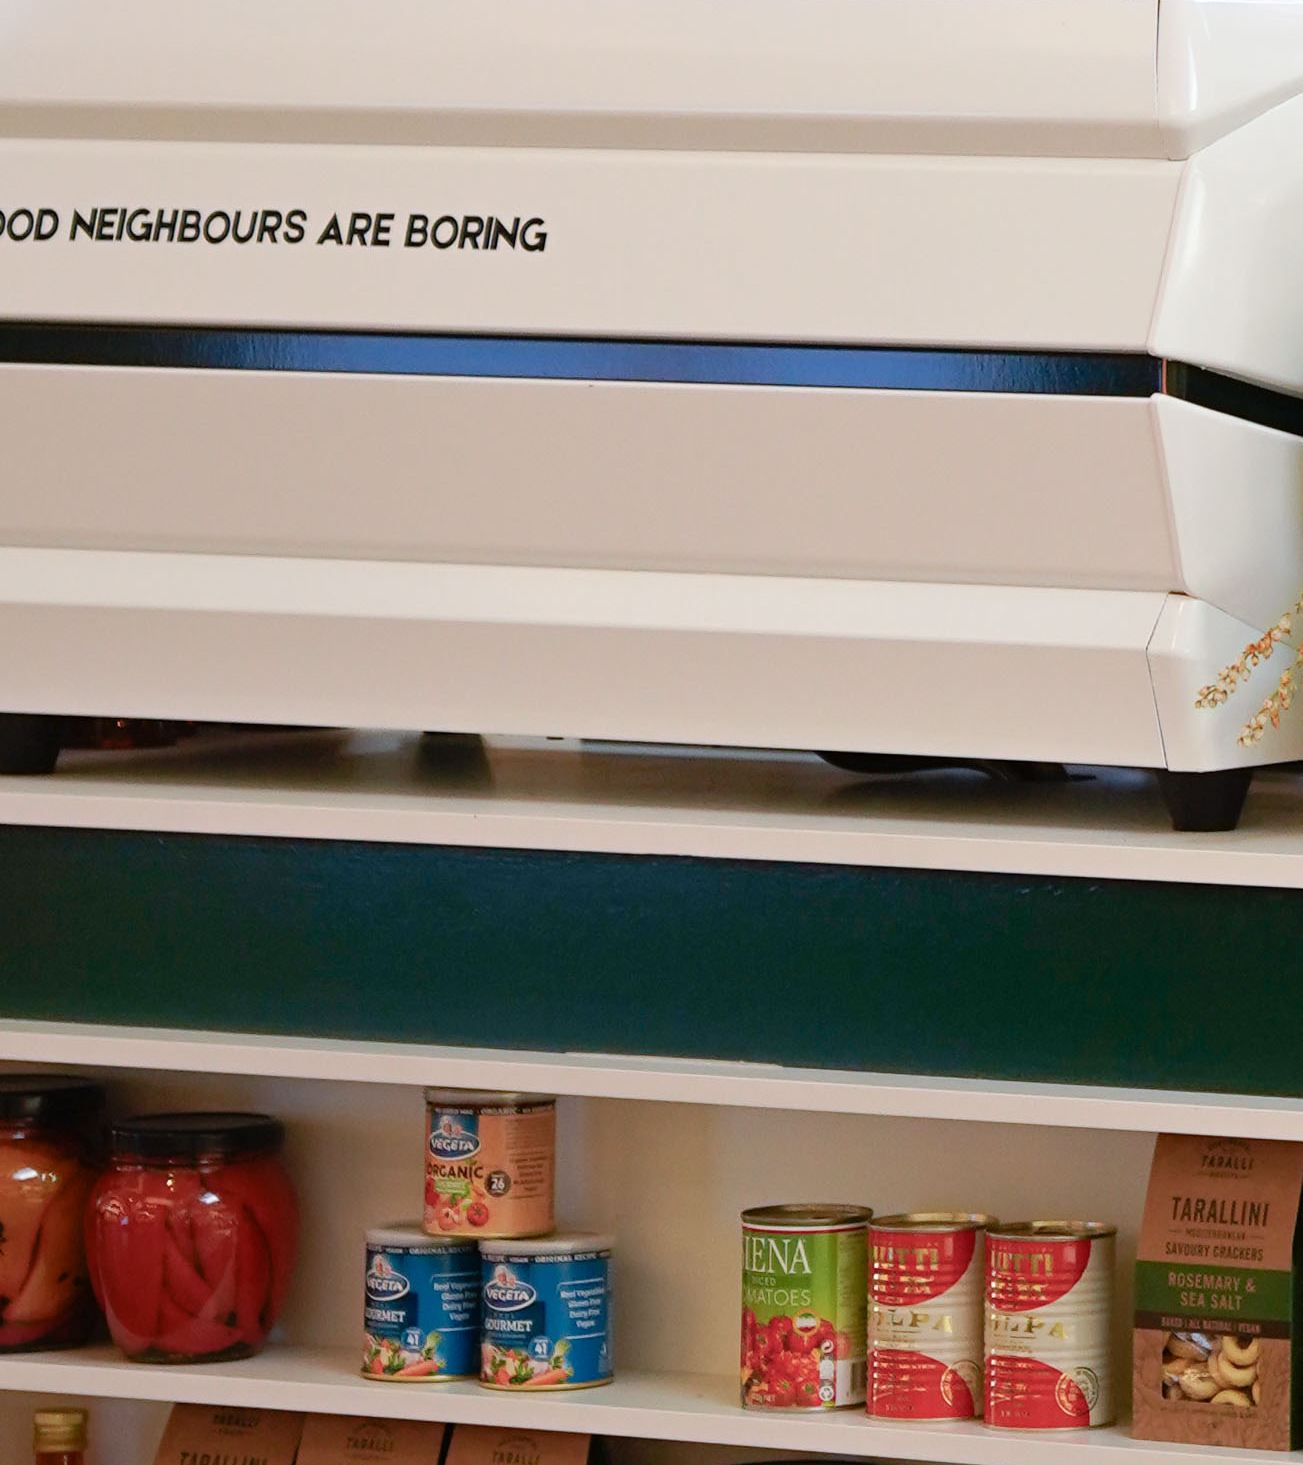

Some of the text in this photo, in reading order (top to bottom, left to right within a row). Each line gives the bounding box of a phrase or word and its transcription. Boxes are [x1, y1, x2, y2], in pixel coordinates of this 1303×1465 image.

[67, 208, 308, 245] NEIGHBOURS
[315, 212, 396, 247] ARE
[402, 213, 548, 252] BORING
[431, 1137, 475, 1152] VEGETA
[491, 1178, 506, 1190] 26
[1170, 1195, 1271, 1228] TARALLINI
[1165, 1241, 1265, 1262] SAVOURY CRACKERS
[1168, 1271, 1257, 1293] ROSEMARY &
[486, 1289, 530, 1301] VEGETA
[1180, 1292, 1243, 1312] SEA SALT
